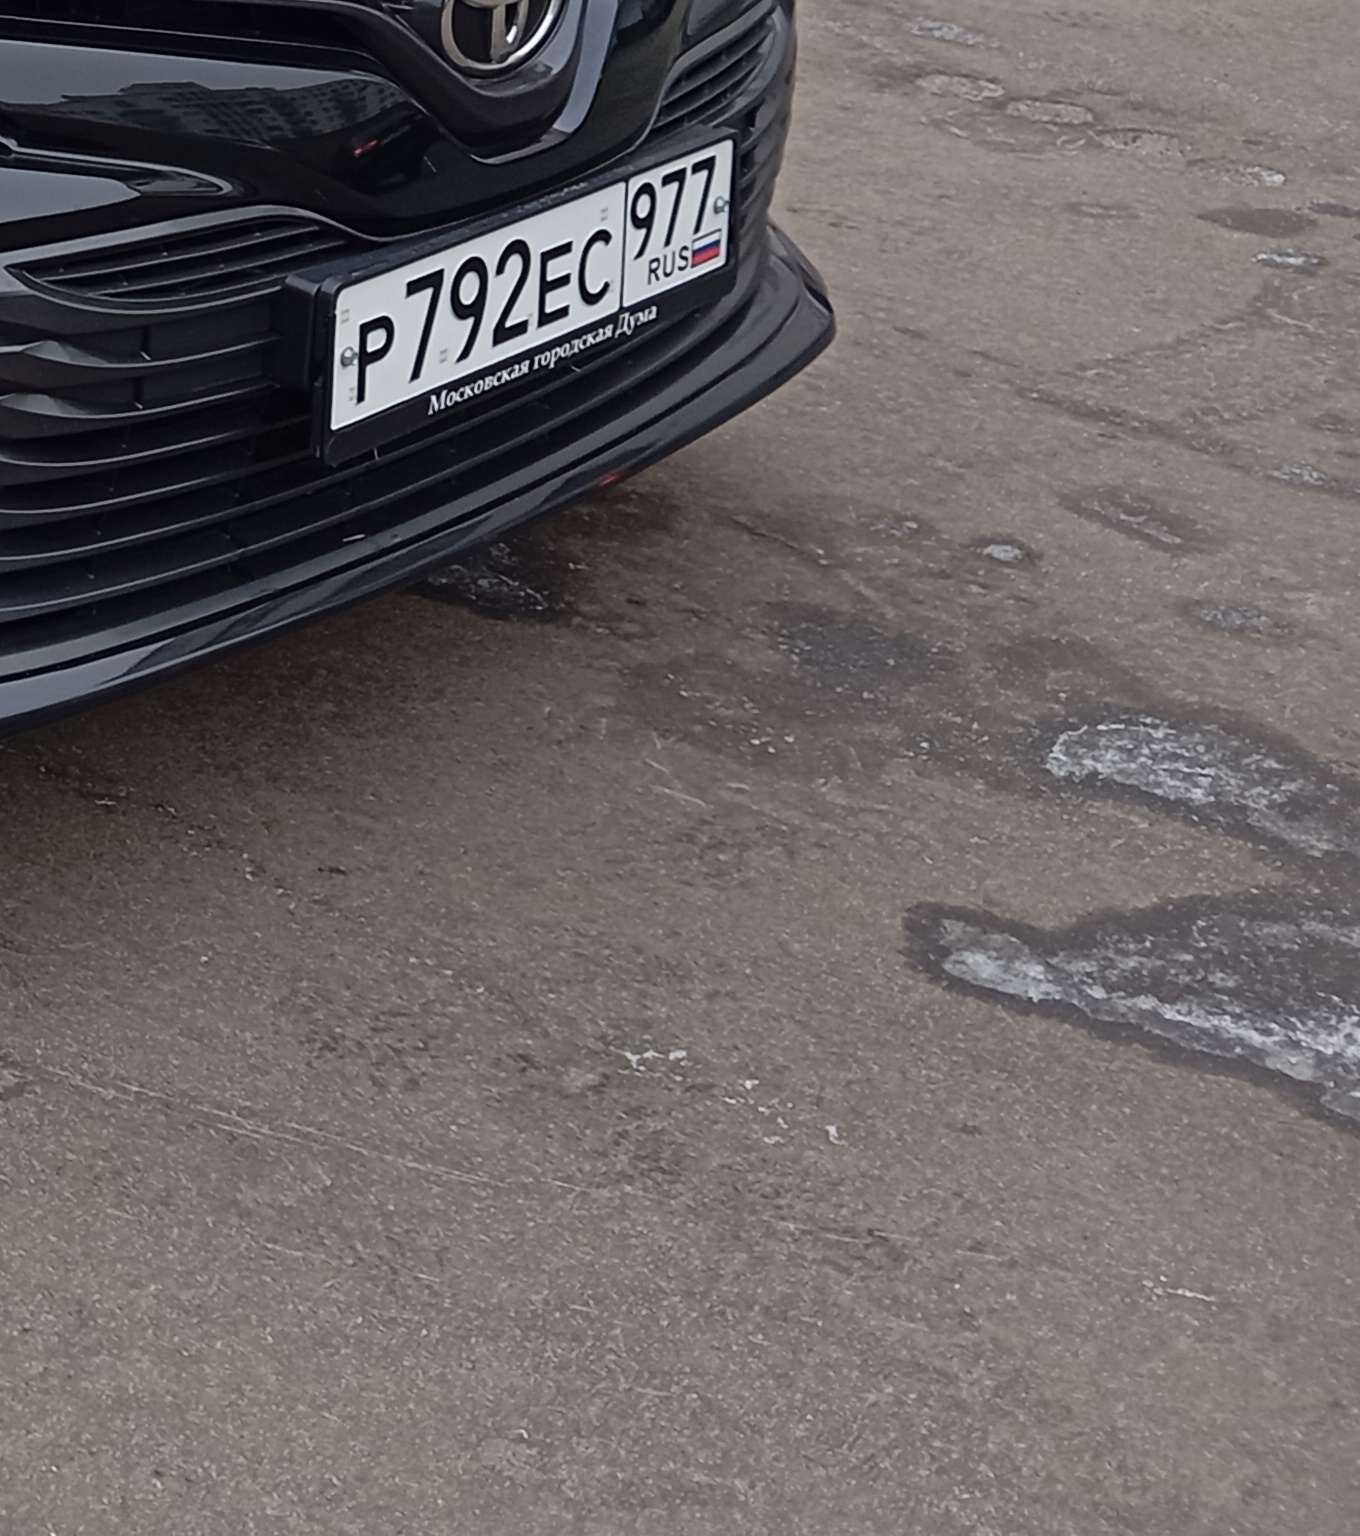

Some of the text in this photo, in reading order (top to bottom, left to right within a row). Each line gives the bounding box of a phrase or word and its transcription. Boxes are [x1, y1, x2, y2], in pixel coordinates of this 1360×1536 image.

[630, 154, 717, 262] 977
[647, 245, 690, 285] RUS
[427, 305, 658, 416] Московская городская Дума
